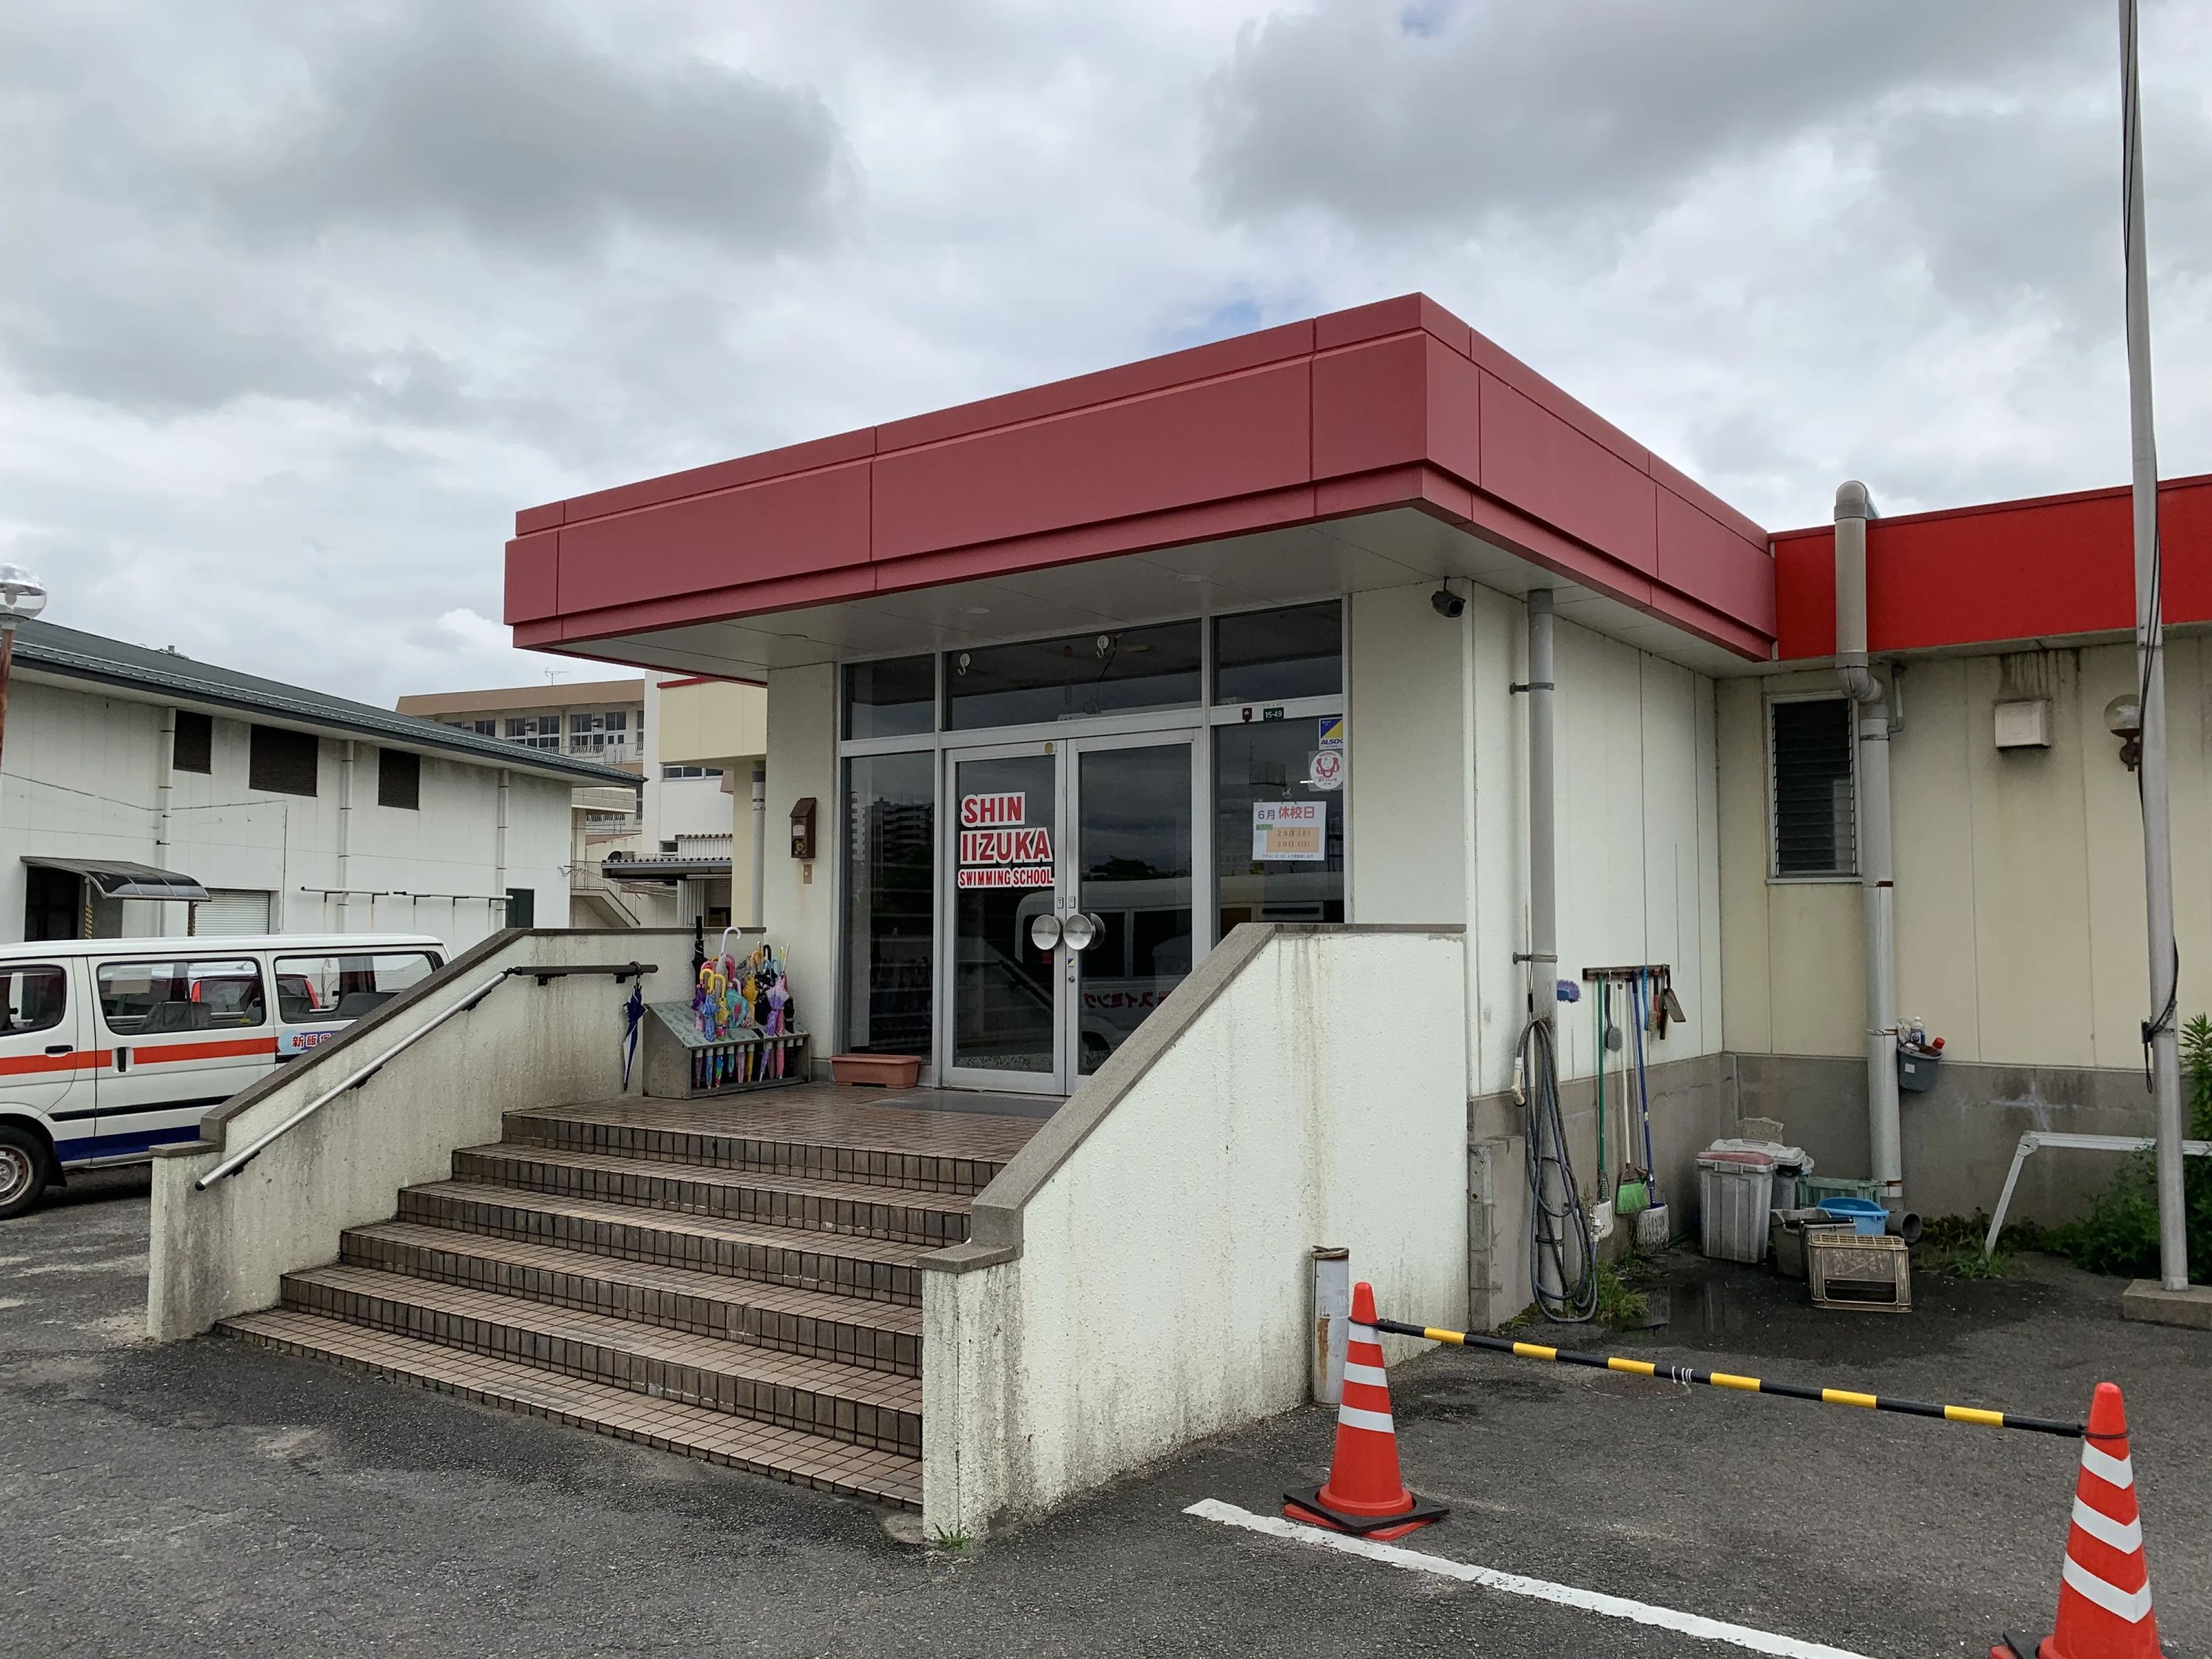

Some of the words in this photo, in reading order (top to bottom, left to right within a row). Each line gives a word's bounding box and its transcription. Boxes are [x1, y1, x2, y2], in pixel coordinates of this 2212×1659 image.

[1265, 710, 1282, 719] 15-49
[963, 796, 1023, 824] SHIN
[962, 830, 1050, 862] IIZUKA
[959, 870, 1011, 886] SWIMMING
[1013, 869, 1053, 885] SCHOOL
